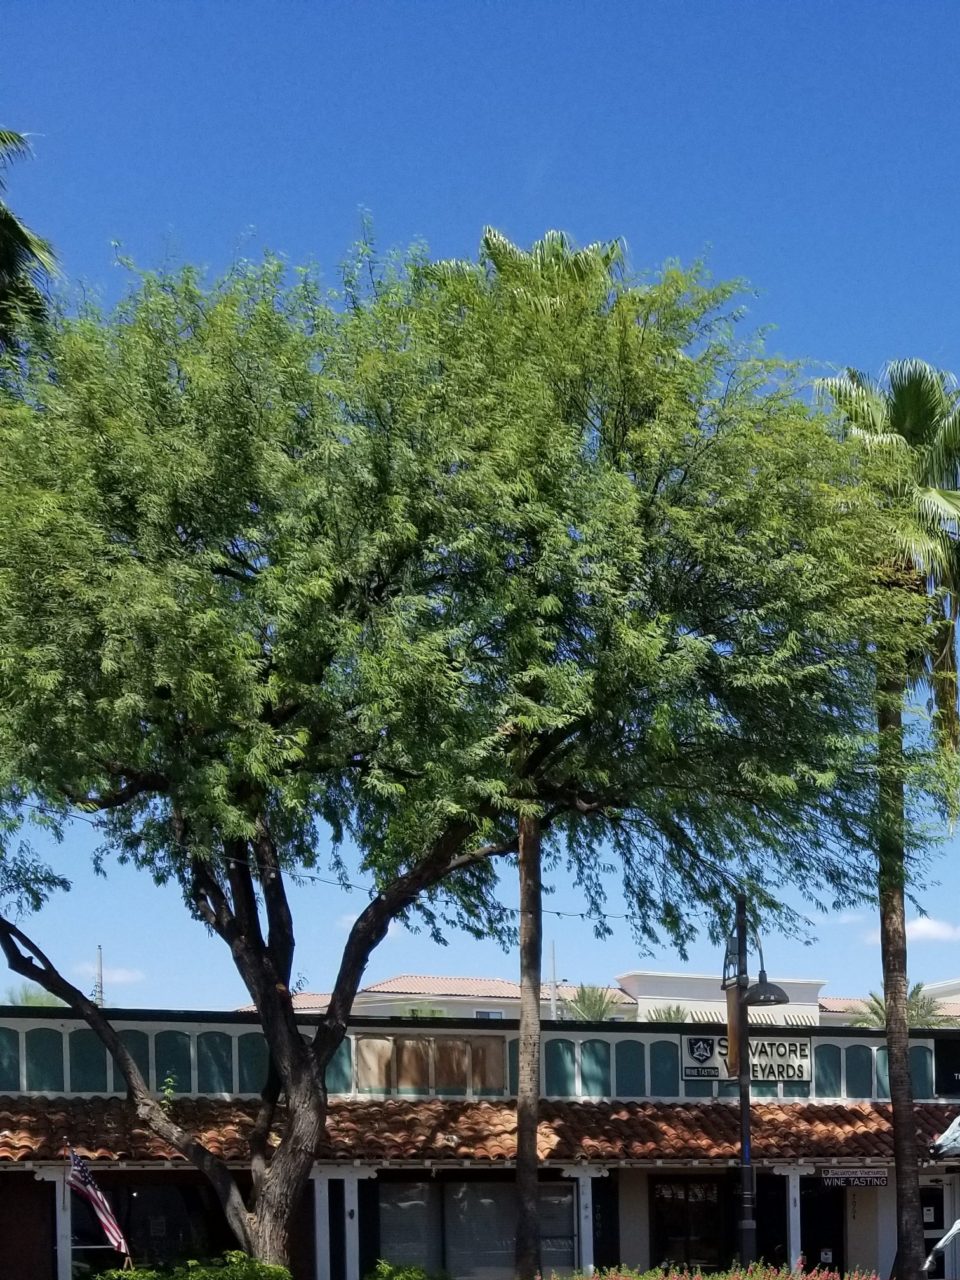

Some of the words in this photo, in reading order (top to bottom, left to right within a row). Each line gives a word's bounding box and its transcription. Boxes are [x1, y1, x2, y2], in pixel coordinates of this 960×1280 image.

[718, 1038, 808, 1058] SVATORE
[823, 1178, 847, 1186] WINE
[849, 1178, 887, 1186] TASTING
